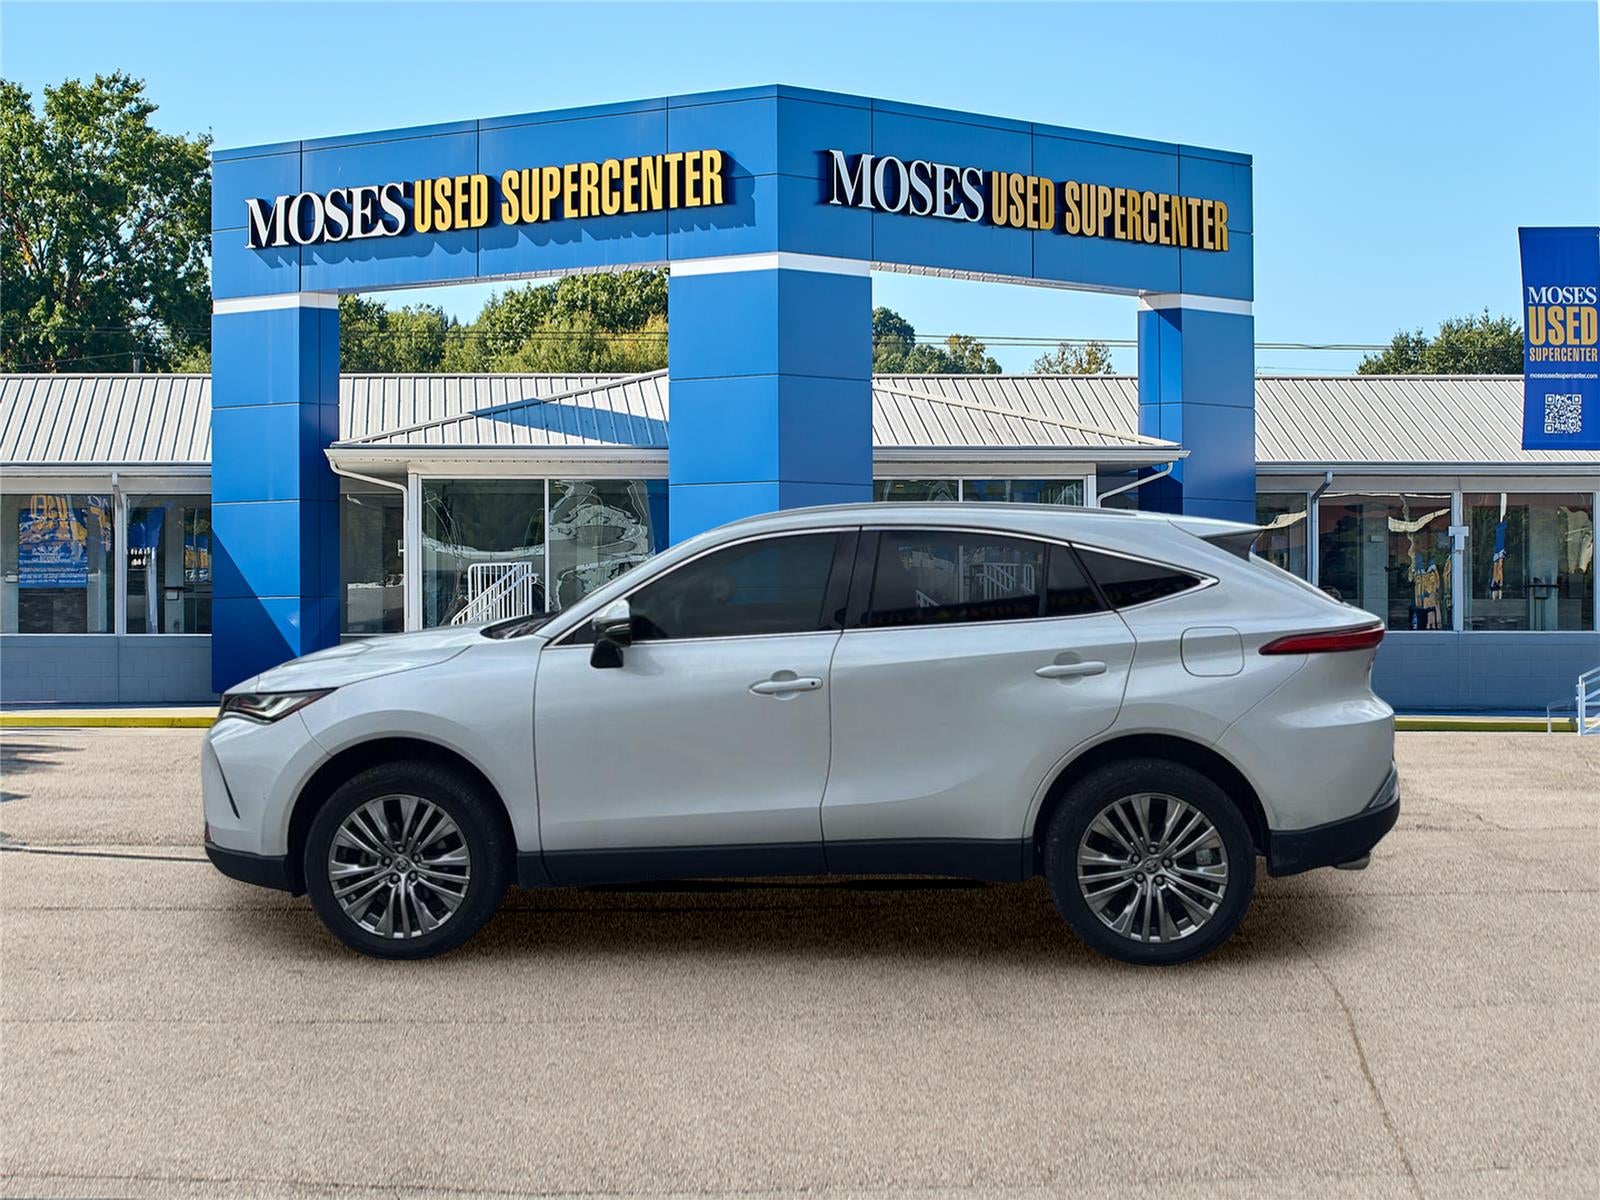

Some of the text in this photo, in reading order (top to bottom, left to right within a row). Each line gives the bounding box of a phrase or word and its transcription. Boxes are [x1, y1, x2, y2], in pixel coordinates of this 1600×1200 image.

[245, 149, 724, 249] MOSES USED SUPERCENTER
[828, 149, 1229, 251] MOSES USED SUPERCENTER
[1528, 286, 1597, 304] MOSES
[1528, 306, 1598, 346] USED
[1529, 347, 1598, 362] SUPERCENTER
